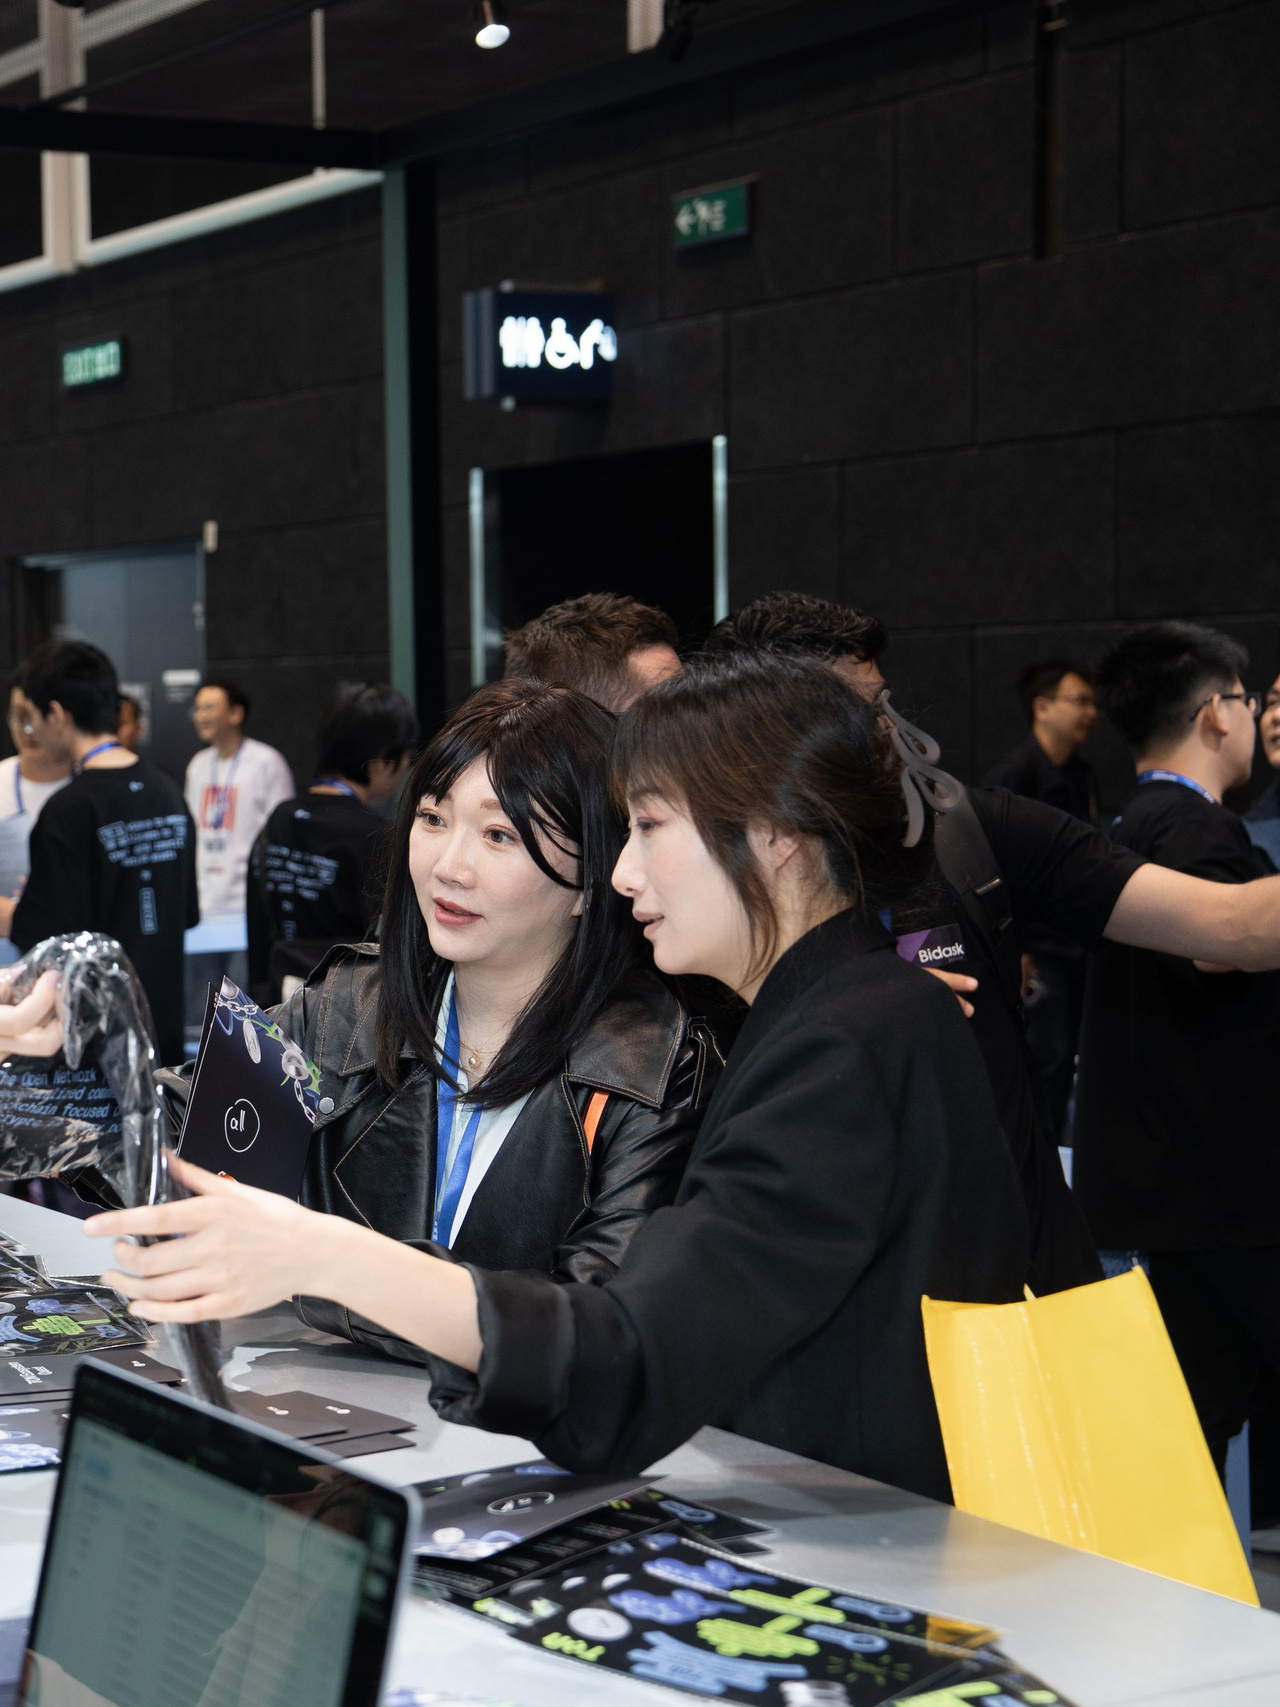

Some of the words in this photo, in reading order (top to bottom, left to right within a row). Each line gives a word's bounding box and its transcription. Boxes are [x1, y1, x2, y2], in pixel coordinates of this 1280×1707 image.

[918, 942, 965, 963] Bidask
[21, 1071, 48, 1087] Open
[53, 1068, 97, 1084] Network
[62, 1103, 110, 1118] focused
